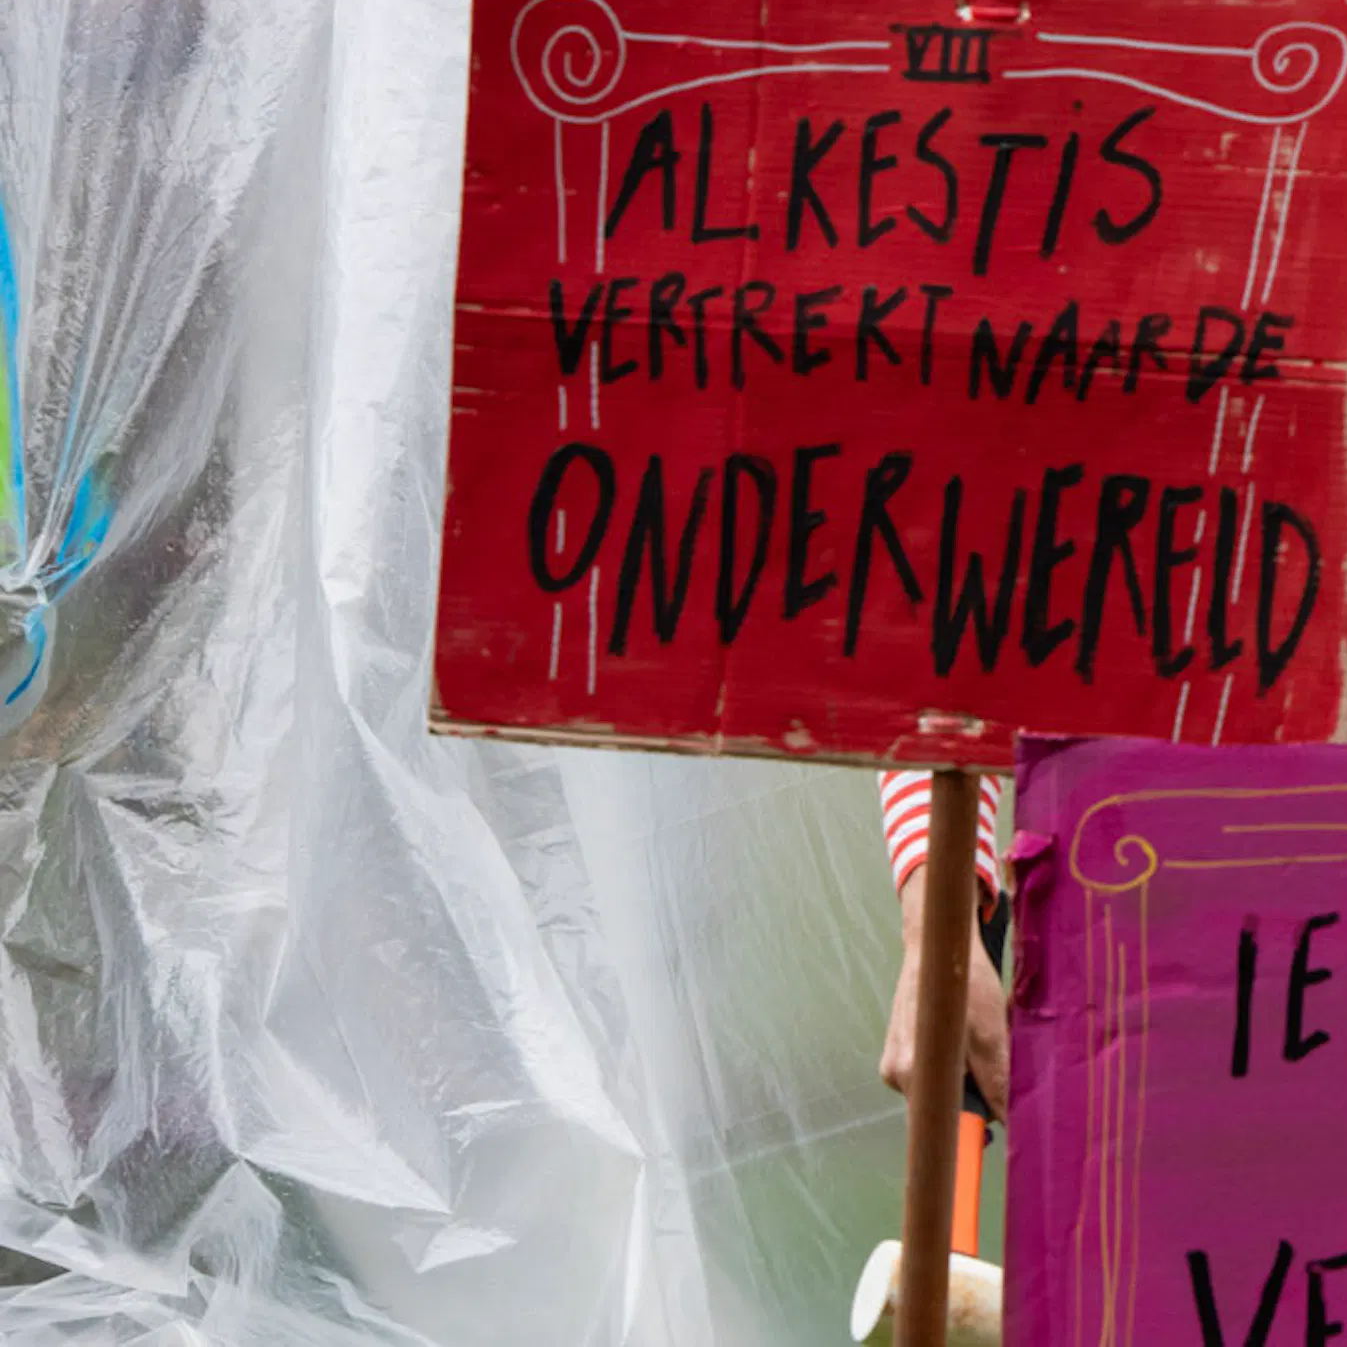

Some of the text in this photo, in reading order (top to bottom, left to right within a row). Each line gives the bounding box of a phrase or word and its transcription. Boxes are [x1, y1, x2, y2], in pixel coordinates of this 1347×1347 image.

[889, 21, 1005, 84] VIII
[549, 271, 1295, 405] VERTREKT NAAR DE
[526, 441, 1325, 700] ONDERWERELD
